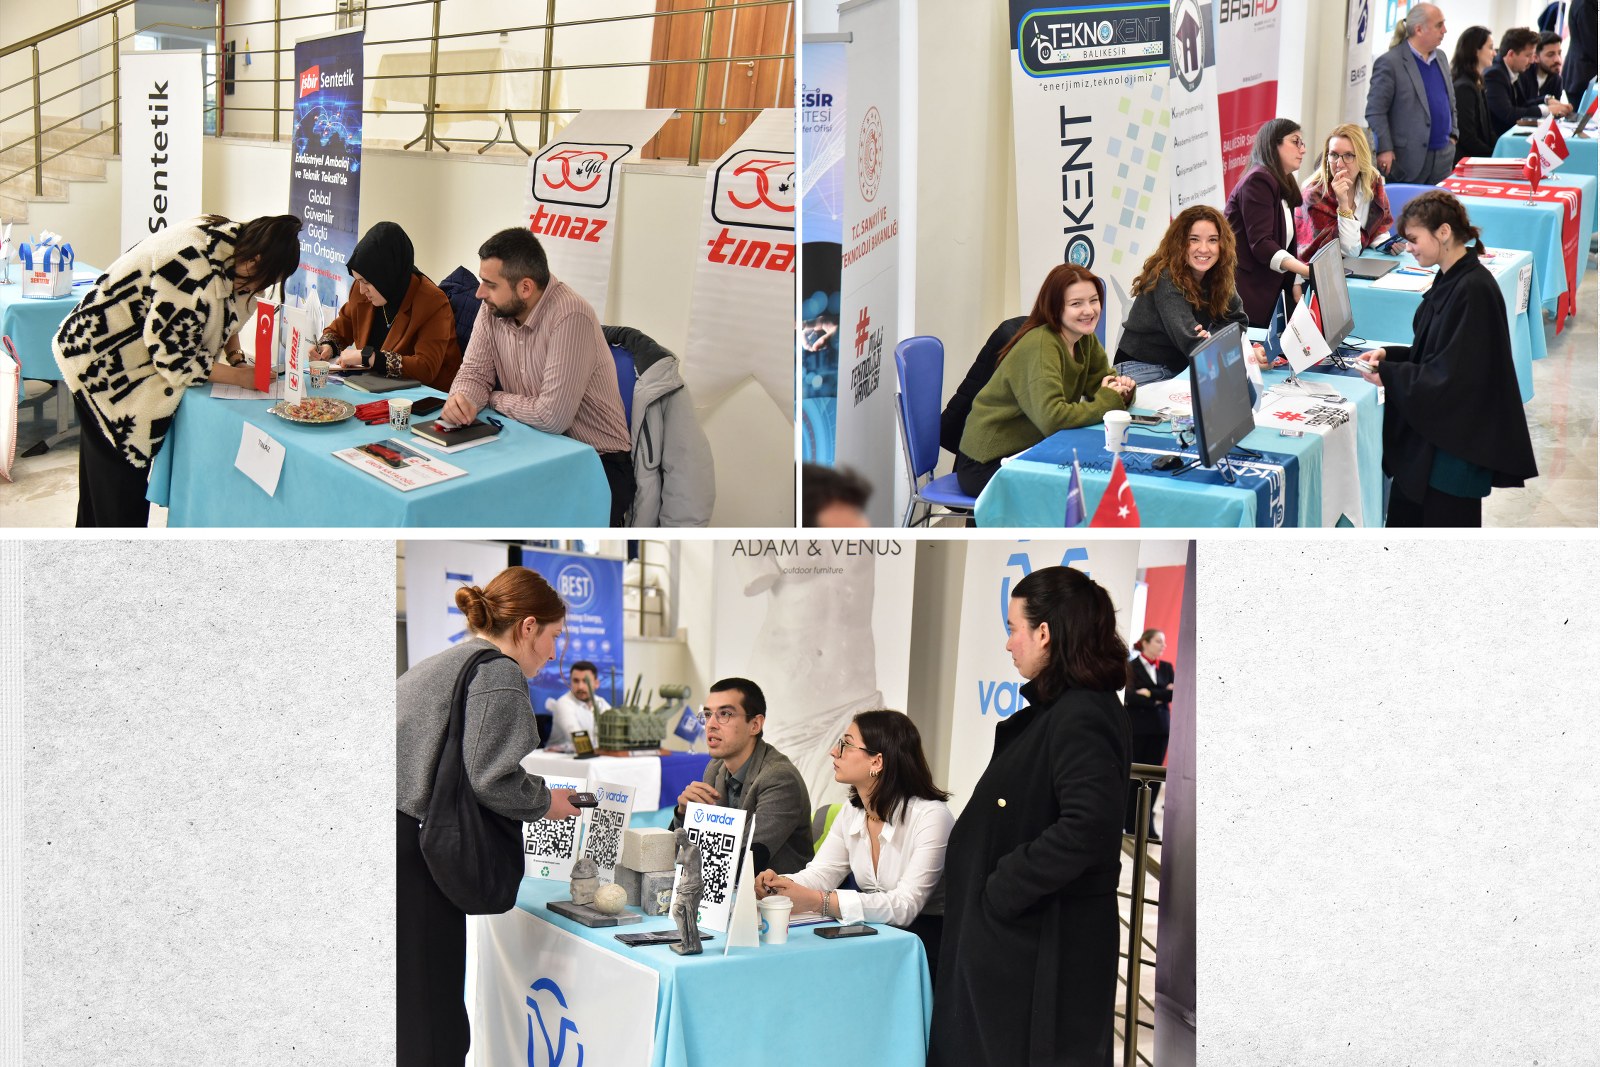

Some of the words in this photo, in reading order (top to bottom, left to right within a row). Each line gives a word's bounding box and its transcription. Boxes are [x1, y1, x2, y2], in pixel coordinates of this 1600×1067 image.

[1083, 47, 1127, 59] BALIKESİR
[320, 68, 354, 88] Sentetik
[148, 79, 170, 235] Sentetik
[309, 189, 332, 206] Global
[304, 205, 334, 224] Güvenilir
[529, 204, 608, 243] tınaz
[308, 223, 328, 242] Güçlü
[313, 242, 345, 264] Ortağınız
[732, 539, 799, 557] ADAM
[807, 539, 822, 556] &
[831, 539, 902, 556] VENUS
[783, 566, 812, 575] outdoor
[813, 566, 844, 575] furniture
[561, 575, 590, 598] BEST
[605, 789, 629, 804] vardar
[706, 812, 735, 826] vardar
